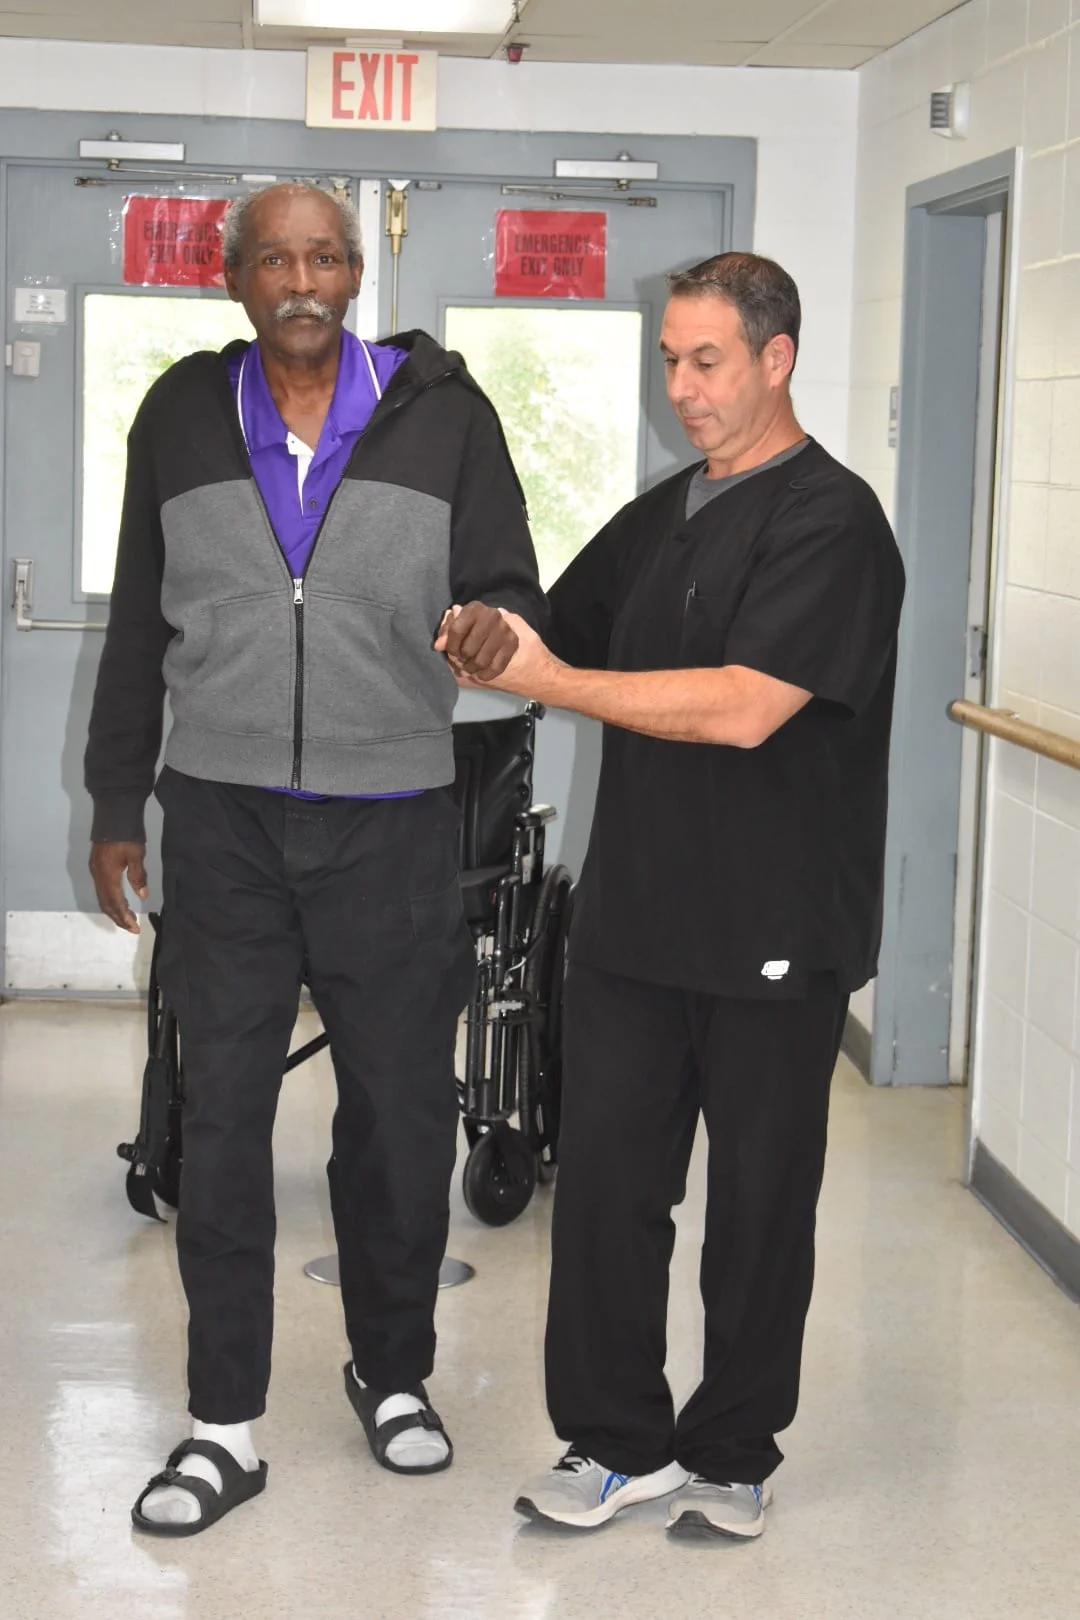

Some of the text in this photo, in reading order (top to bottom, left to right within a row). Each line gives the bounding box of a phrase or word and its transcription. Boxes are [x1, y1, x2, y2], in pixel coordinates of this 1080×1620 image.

[332, 52, 419, 122] EXIT
[150, 244, 213, 265] EXIT ONLY
[514, 233, 590, 255] EMERGENCY
[521, 256, 584, 276] EXIT ONLY
